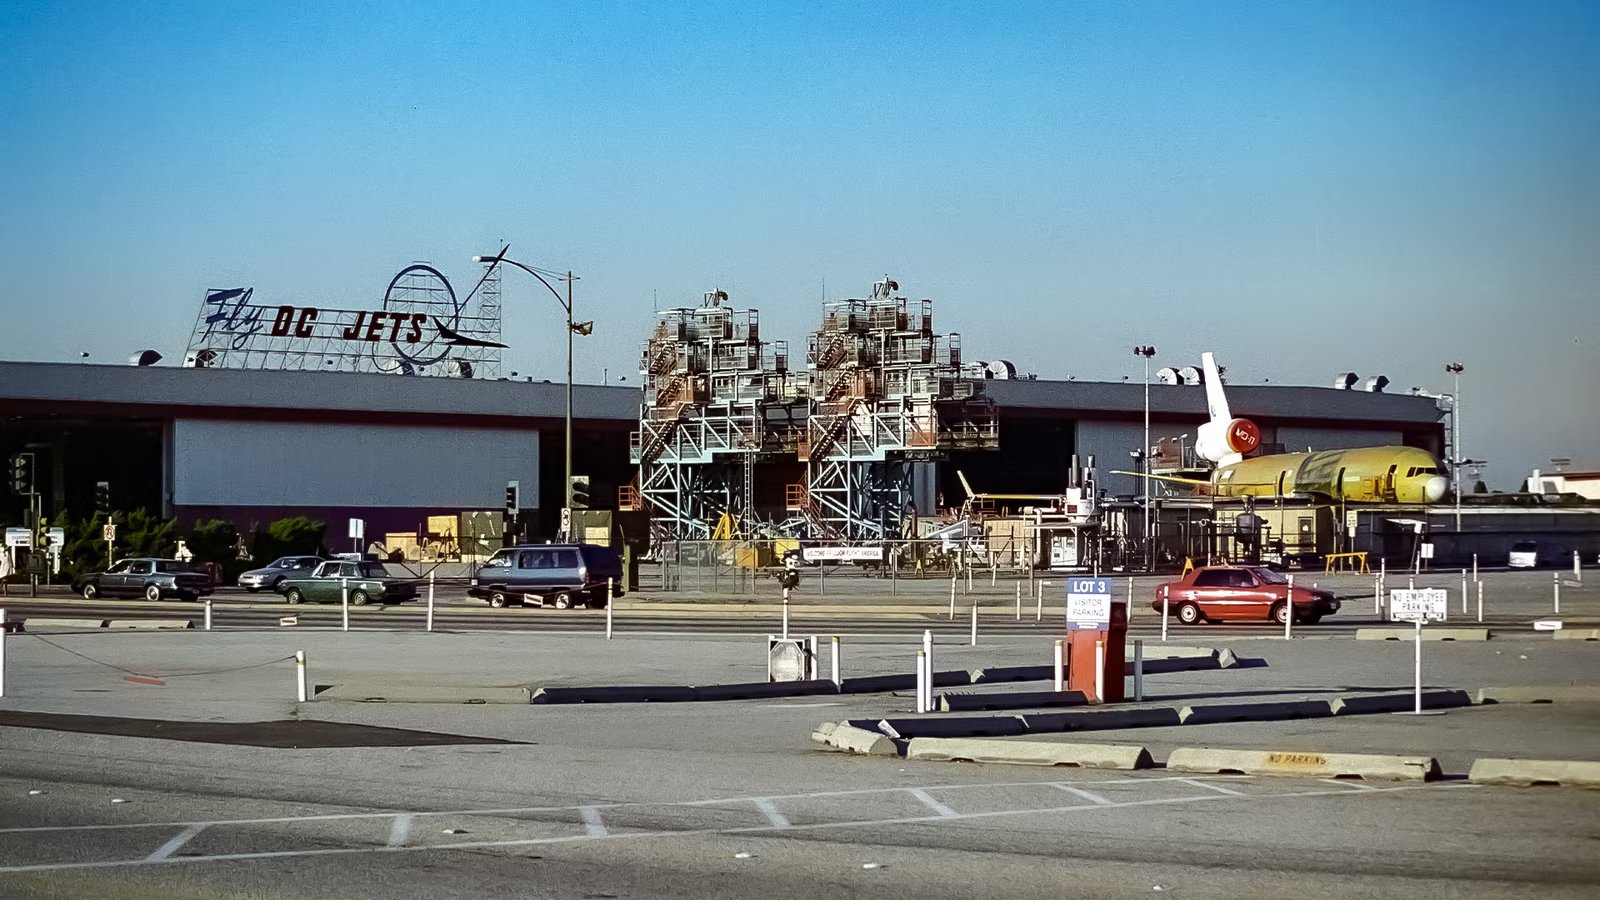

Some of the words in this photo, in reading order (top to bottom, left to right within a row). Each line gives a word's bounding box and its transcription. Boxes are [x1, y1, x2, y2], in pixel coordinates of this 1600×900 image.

[200, 287, 264, 350] Fly
[270, 305, 319, 339] DC
[343, 310, 427, 344] JETS
[1235, 427, 1256, 445] MD-11
[1073, 580, 1096, 593] LOT
[1097, 580, 1106, 593] 3
[1392, 592, 1402, 602] NO
[1406, 592, 1444, 602] EMPLOYEE
[1074, 598, 1103, 607] VISITOR
[1402, 602, 1435, 612] PARKING
[1072, 608, 1104, 617] PARKING
[1268, 754, 1282, 763] NO
[1284, 754, 1327, 765] PARKING
